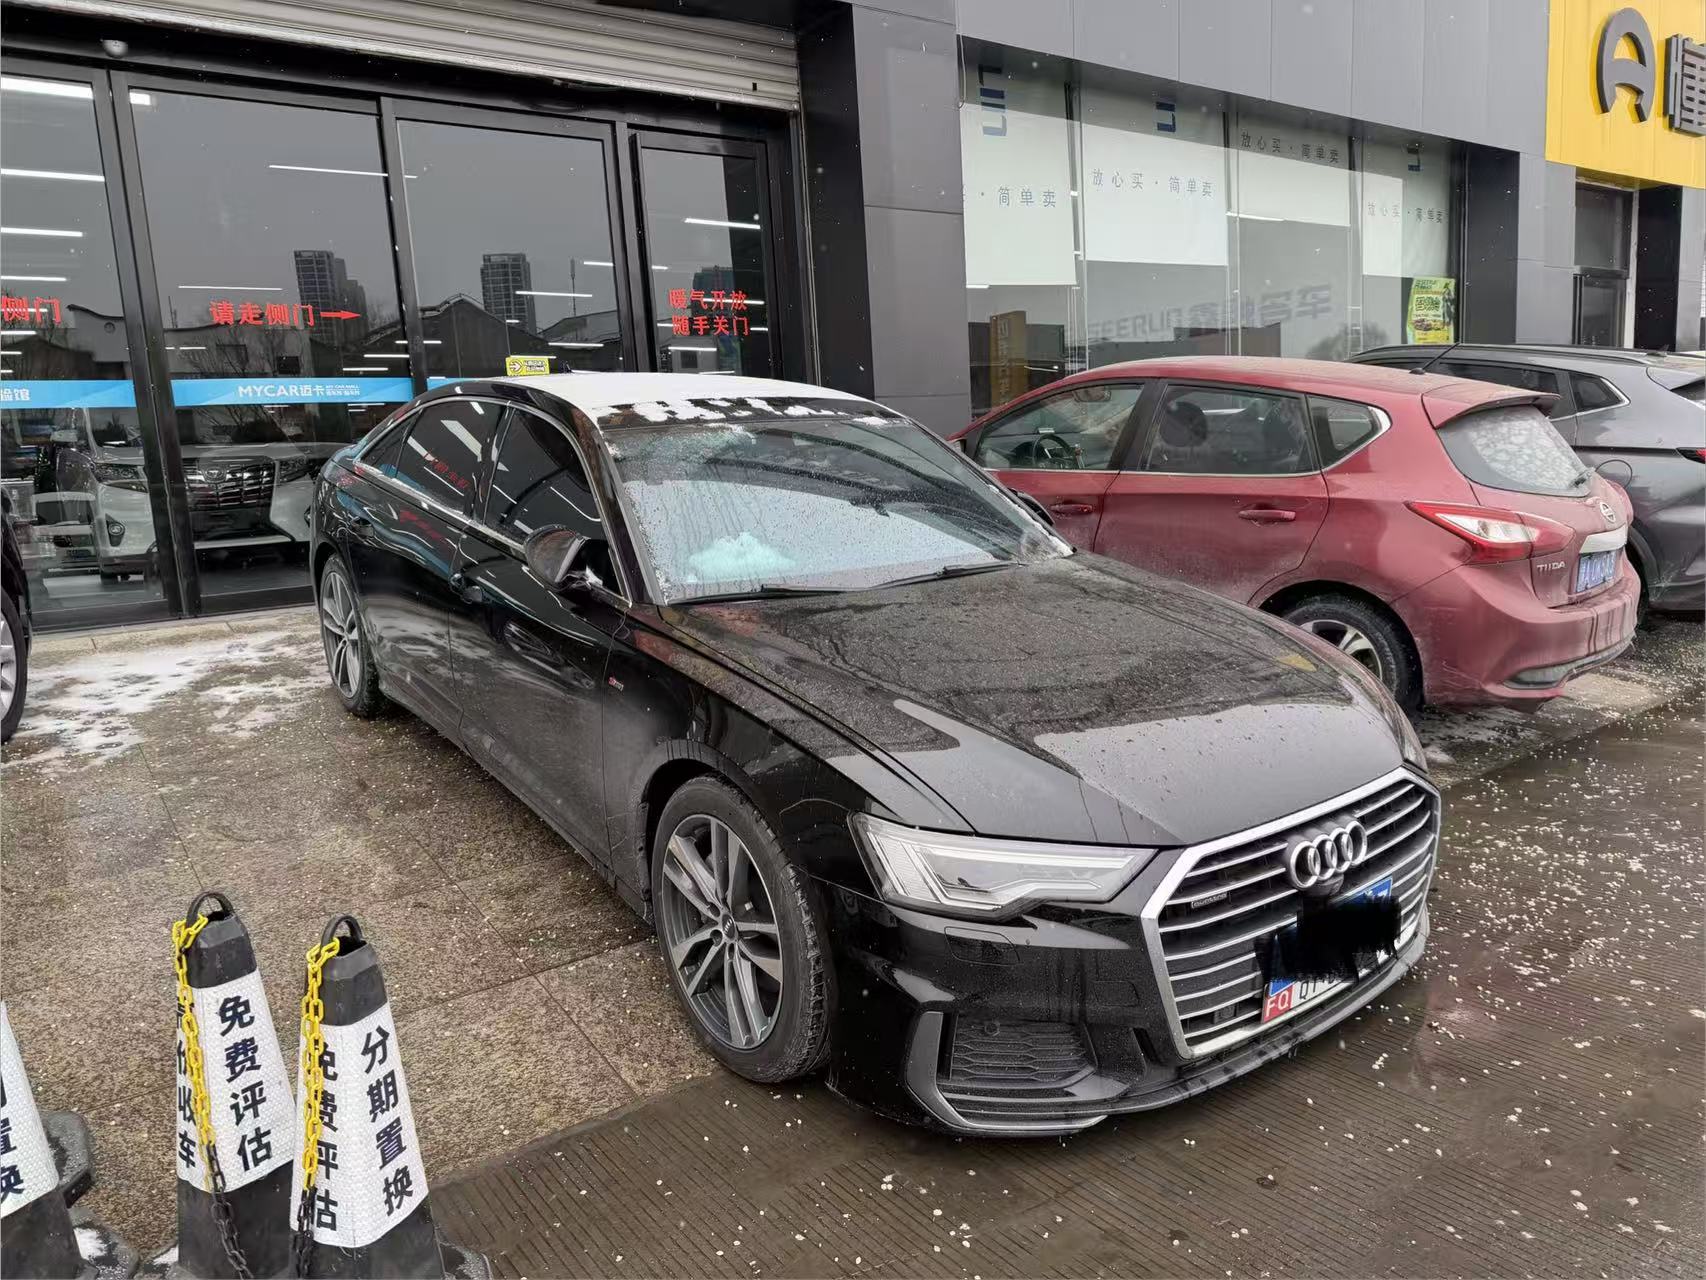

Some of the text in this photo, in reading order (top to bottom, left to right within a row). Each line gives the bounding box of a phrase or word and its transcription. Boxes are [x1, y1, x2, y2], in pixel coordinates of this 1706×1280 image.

[1091, 168, 1214, 197] 放心买·简单卖
[1, 296, 61, 323] 侧门
[669, 288, 748, 310] 暖气开放
[209, 300, 315, 327] 请走侧门
[672, 315, 750, 336] 随手关门
[1536, 561, 1567, 572] TIIDA
[1265, 990, 1290, 1018] FQ
[218, 995, 272, 1172] 免费评估
[360, 1025, 414, 1217] 分期置换
[0, 1073, 24, 1203] 置换
